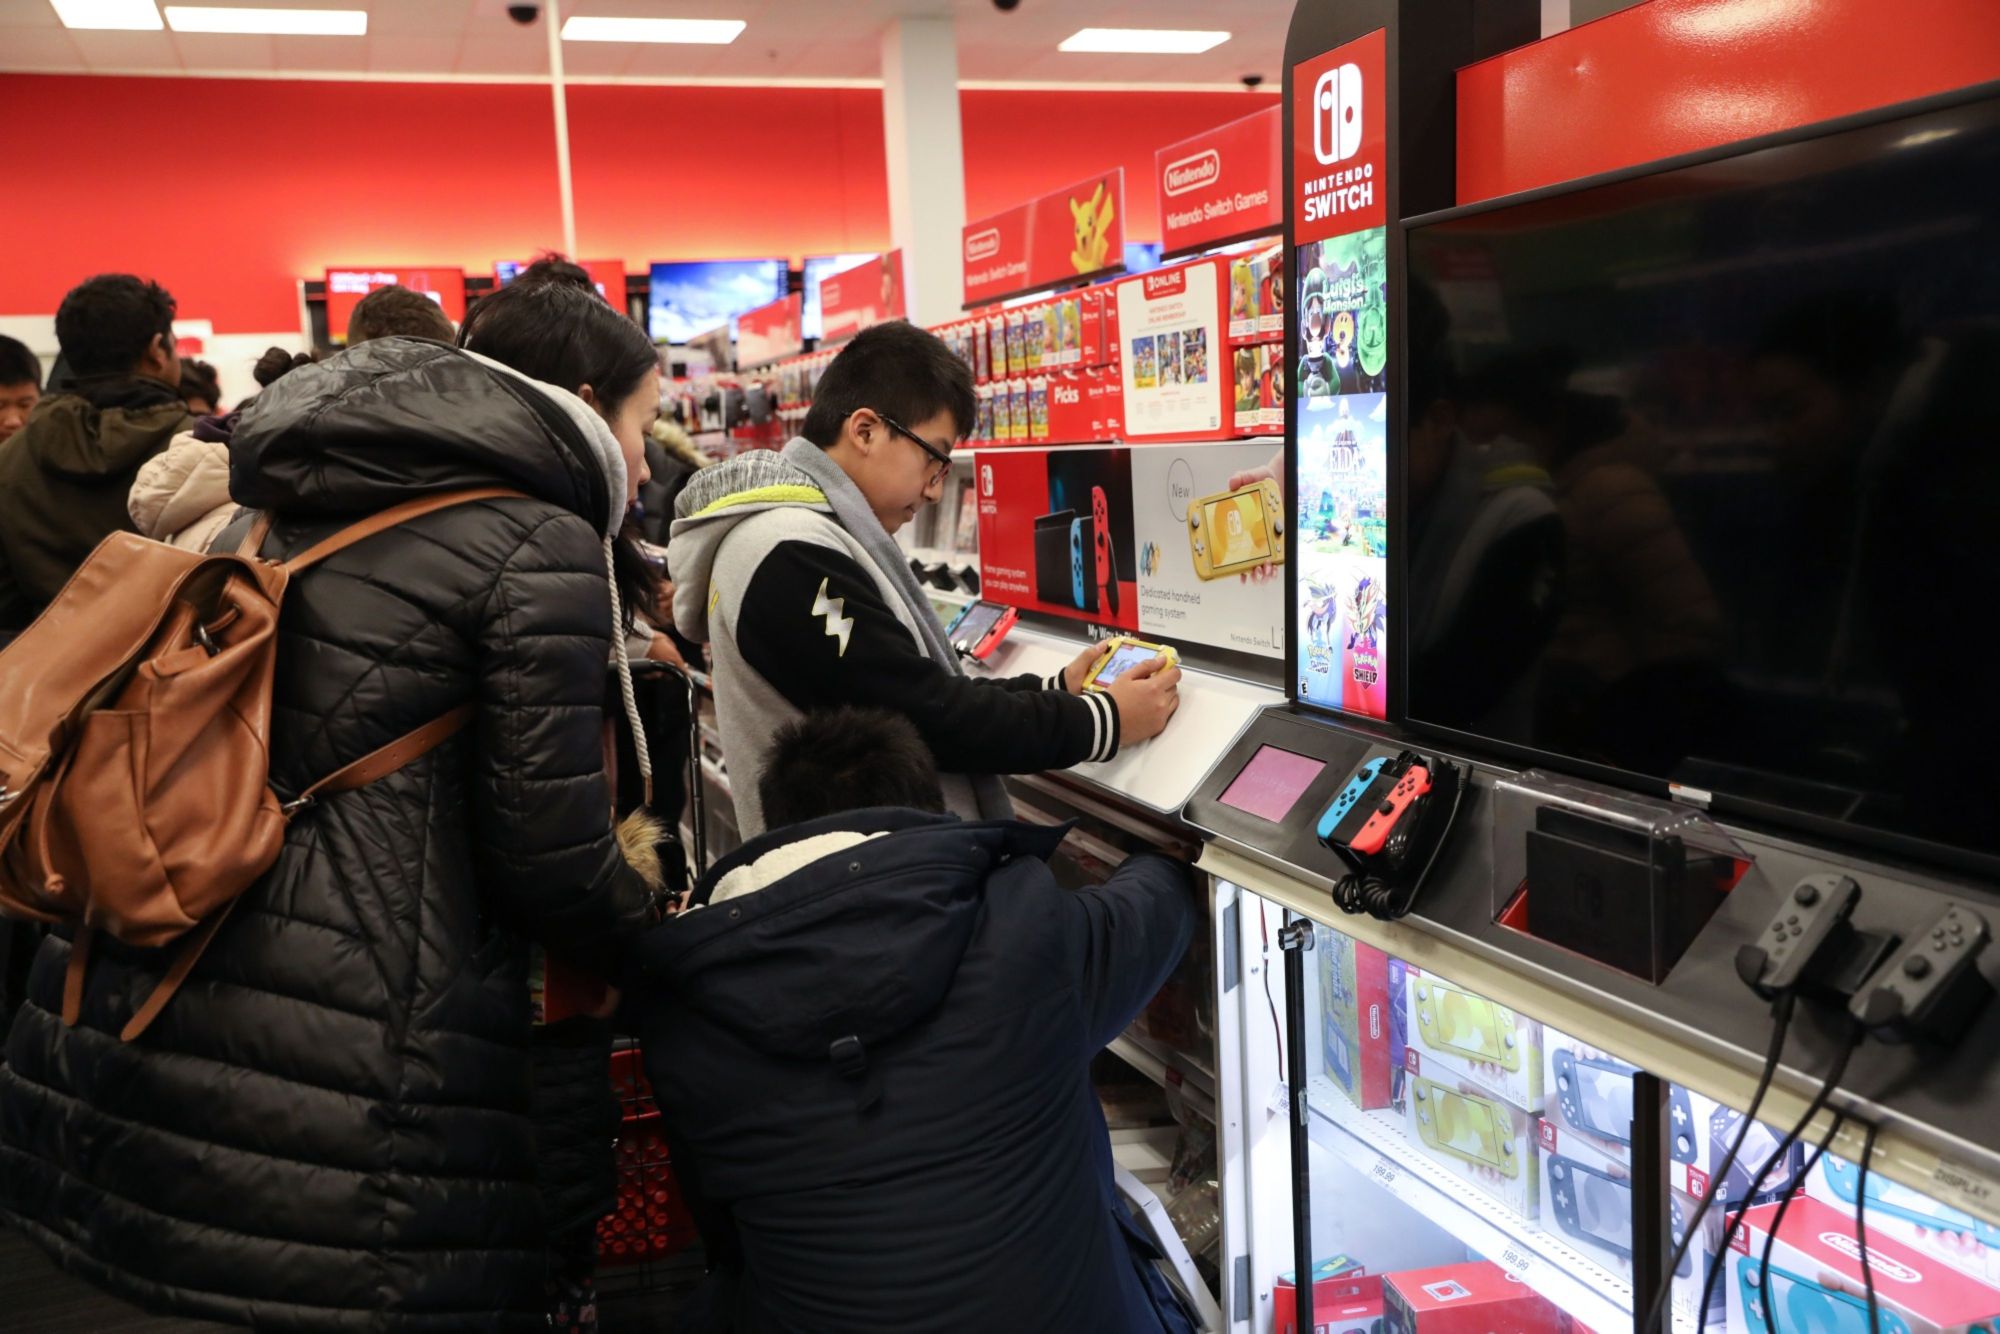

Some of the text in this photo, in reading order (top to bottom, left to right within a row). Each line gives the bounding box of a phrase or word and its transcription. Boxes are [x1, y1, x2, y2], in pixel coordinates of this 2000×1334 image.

[1168, 159, 1215, 189] Nintendo
[1304, 163, 1373, 195] NINTENDO
[1166, 190, 1268, 230] Nintendo Switch Games
[1304, 181, 1373, 222] SWITCH
[1153, 272, 1181, 289] ONLINE
[1322, 273, 1365, 299] Luigi's
[1054, 385, 1080, 405] Picks
[1171, 483, 1190, 498] New
[1140, 585, 1201, 605] Dedicated handheld
[1141, 604, 1187, 620] gaming system
[1087, 624, 1098, 640] My
[1230, 626, 1285, 651] Nintendo Switch Li
[1354, 668, 1378, 684] SHIELD
[1371, 1007, 1379, 1036] Nintendo
[1372, 1164, 1396, 1183] 199.99
[1933, 1167, 1992, 1199] DISPLAY
[1501, 1249, 1530, 1272] 199.99
[1828, 1234, 1909, 1280] Ninendo
